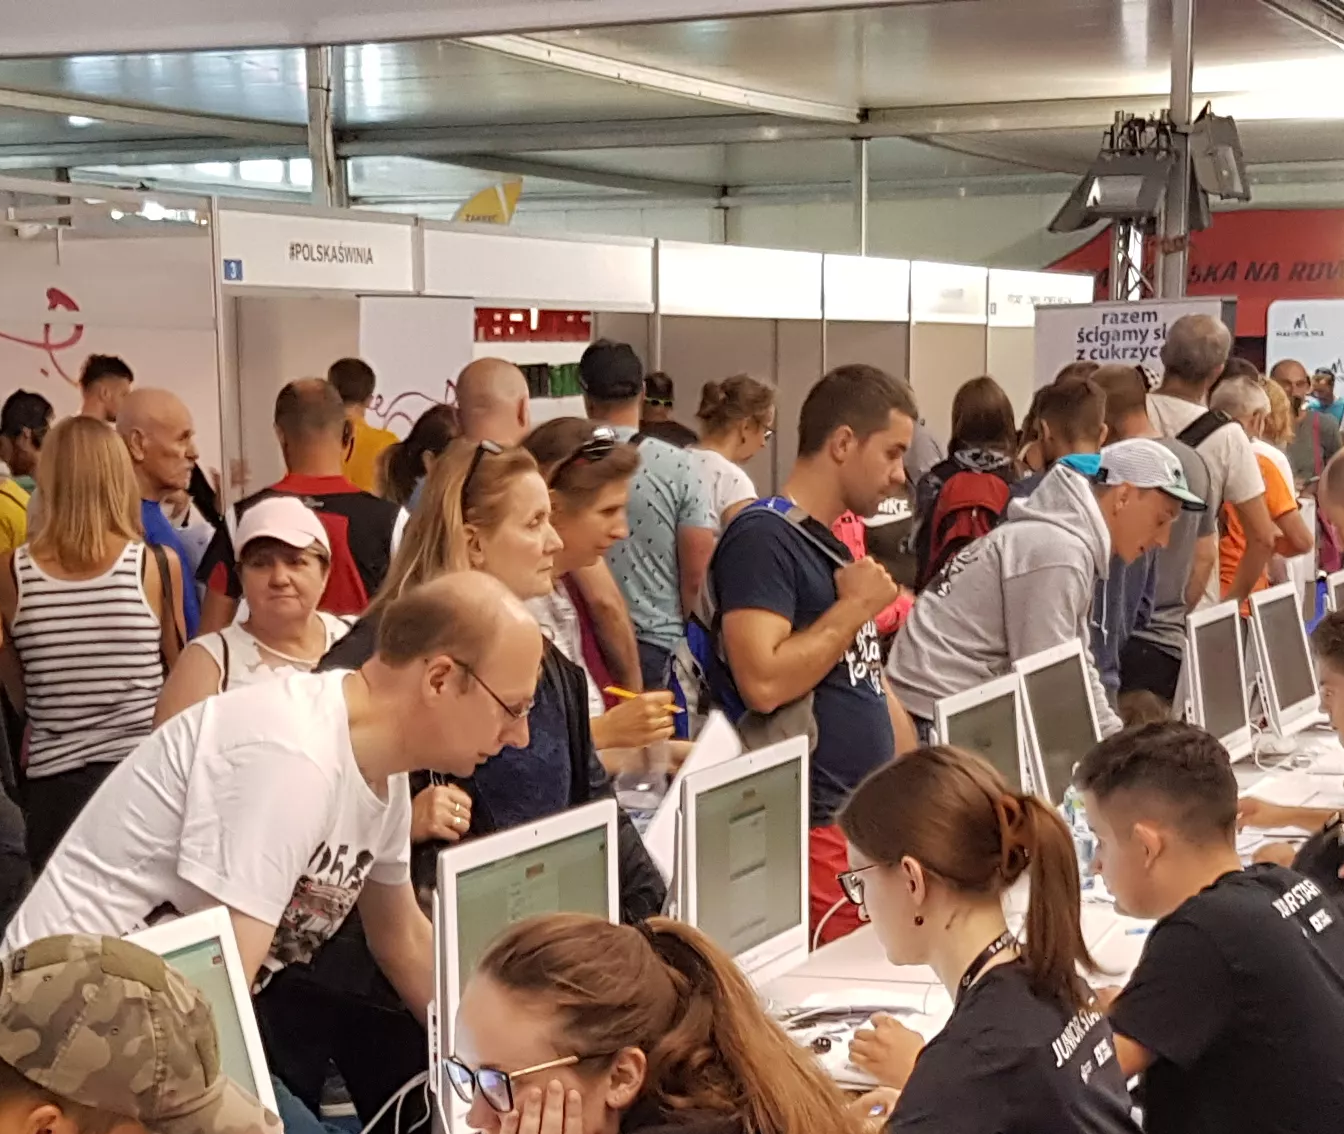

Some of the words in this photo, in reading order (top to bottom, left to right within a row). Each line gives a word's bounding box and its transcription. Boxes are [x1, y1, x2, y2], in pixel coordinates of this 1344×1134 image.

[228, 260, 238, 279] 3
[1244, 261, 1280, 282] NA
[1101, 310, 1158, 325] razem
[1076, 326, 1149, 346] ścigamy
[1153, 322, 1167, 341] si
[1076, 348, 1086, 361] z
[1089, 344, 1159, 362] cukrzyc
